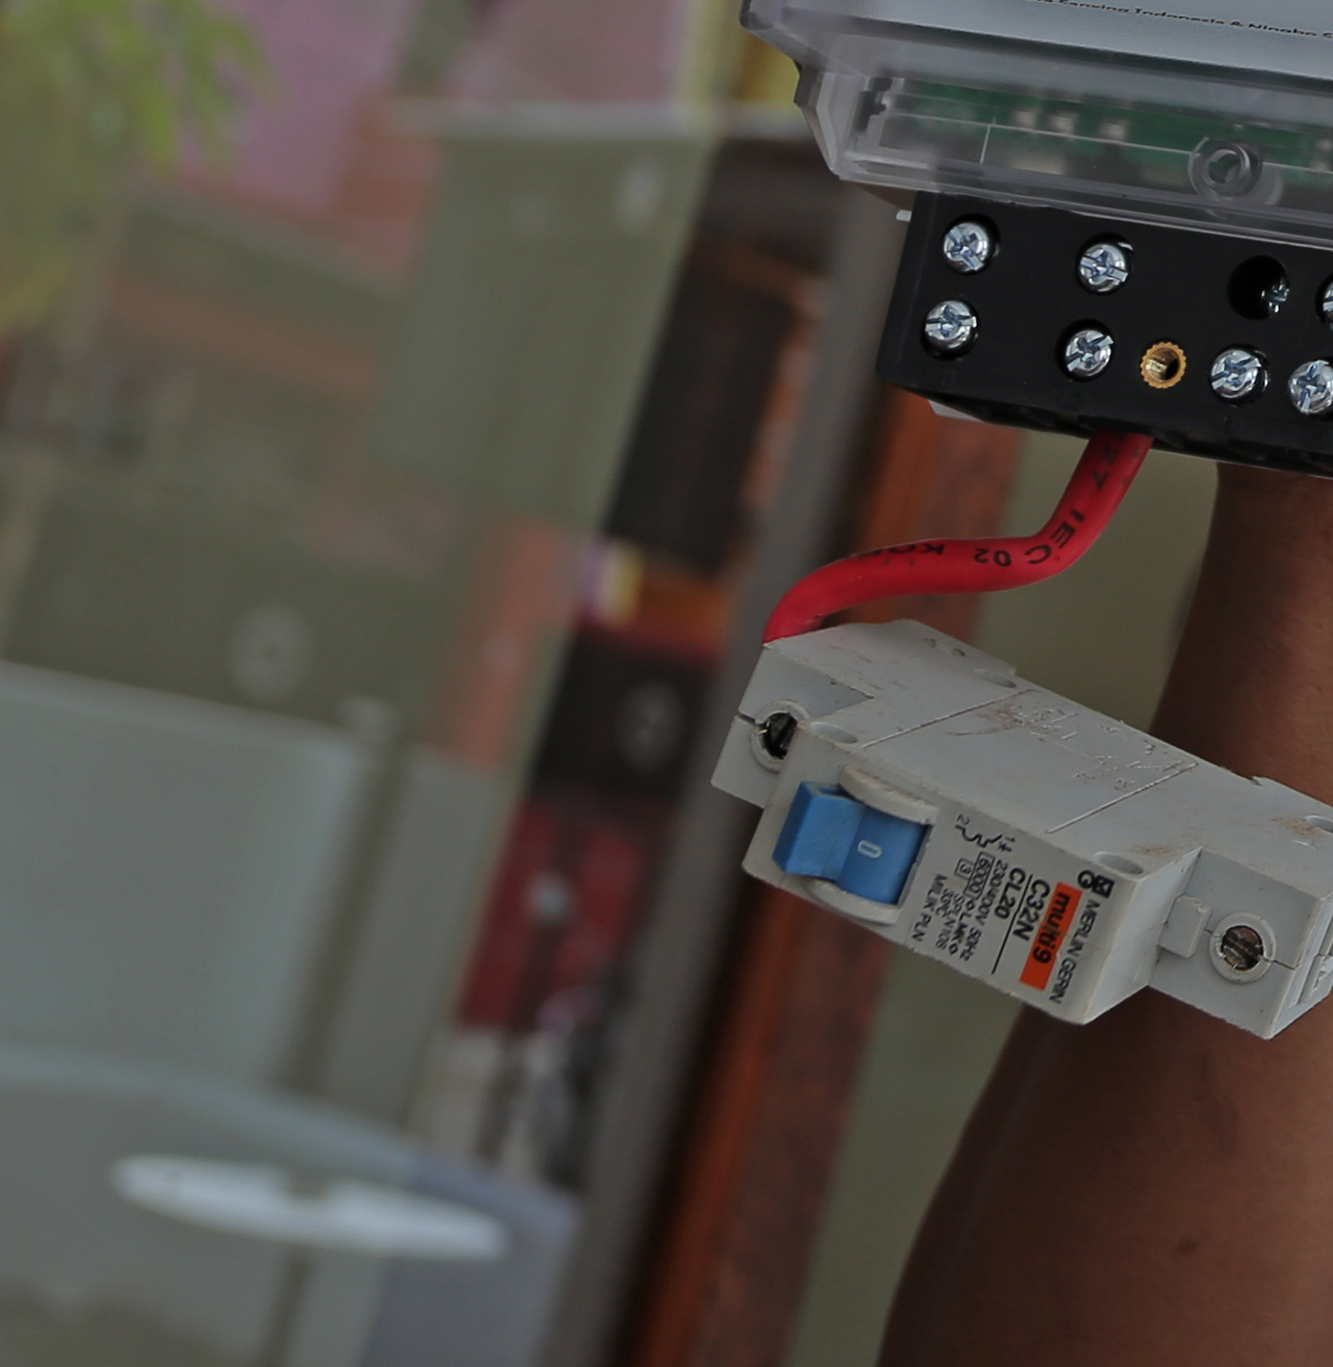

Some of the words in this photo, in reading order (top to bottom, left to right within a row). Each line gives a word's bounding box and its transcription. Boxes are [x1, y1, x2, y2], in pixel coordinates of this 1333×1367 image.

[973, 547, 1013, 568] 02
[1024, 509, 1086, 566] IEC
[923, 873, 947, 911] MILIK
[968, 858, 990, 894] 6000
[993, 866, 1027, 920] CL20
[910, 912, 931, 941] PLN
[1012, 877, 1052, 941] C32N
[1066, 899, 1100, 957] MERLIN
[1048, 957, 1076, 1004] GERIN
